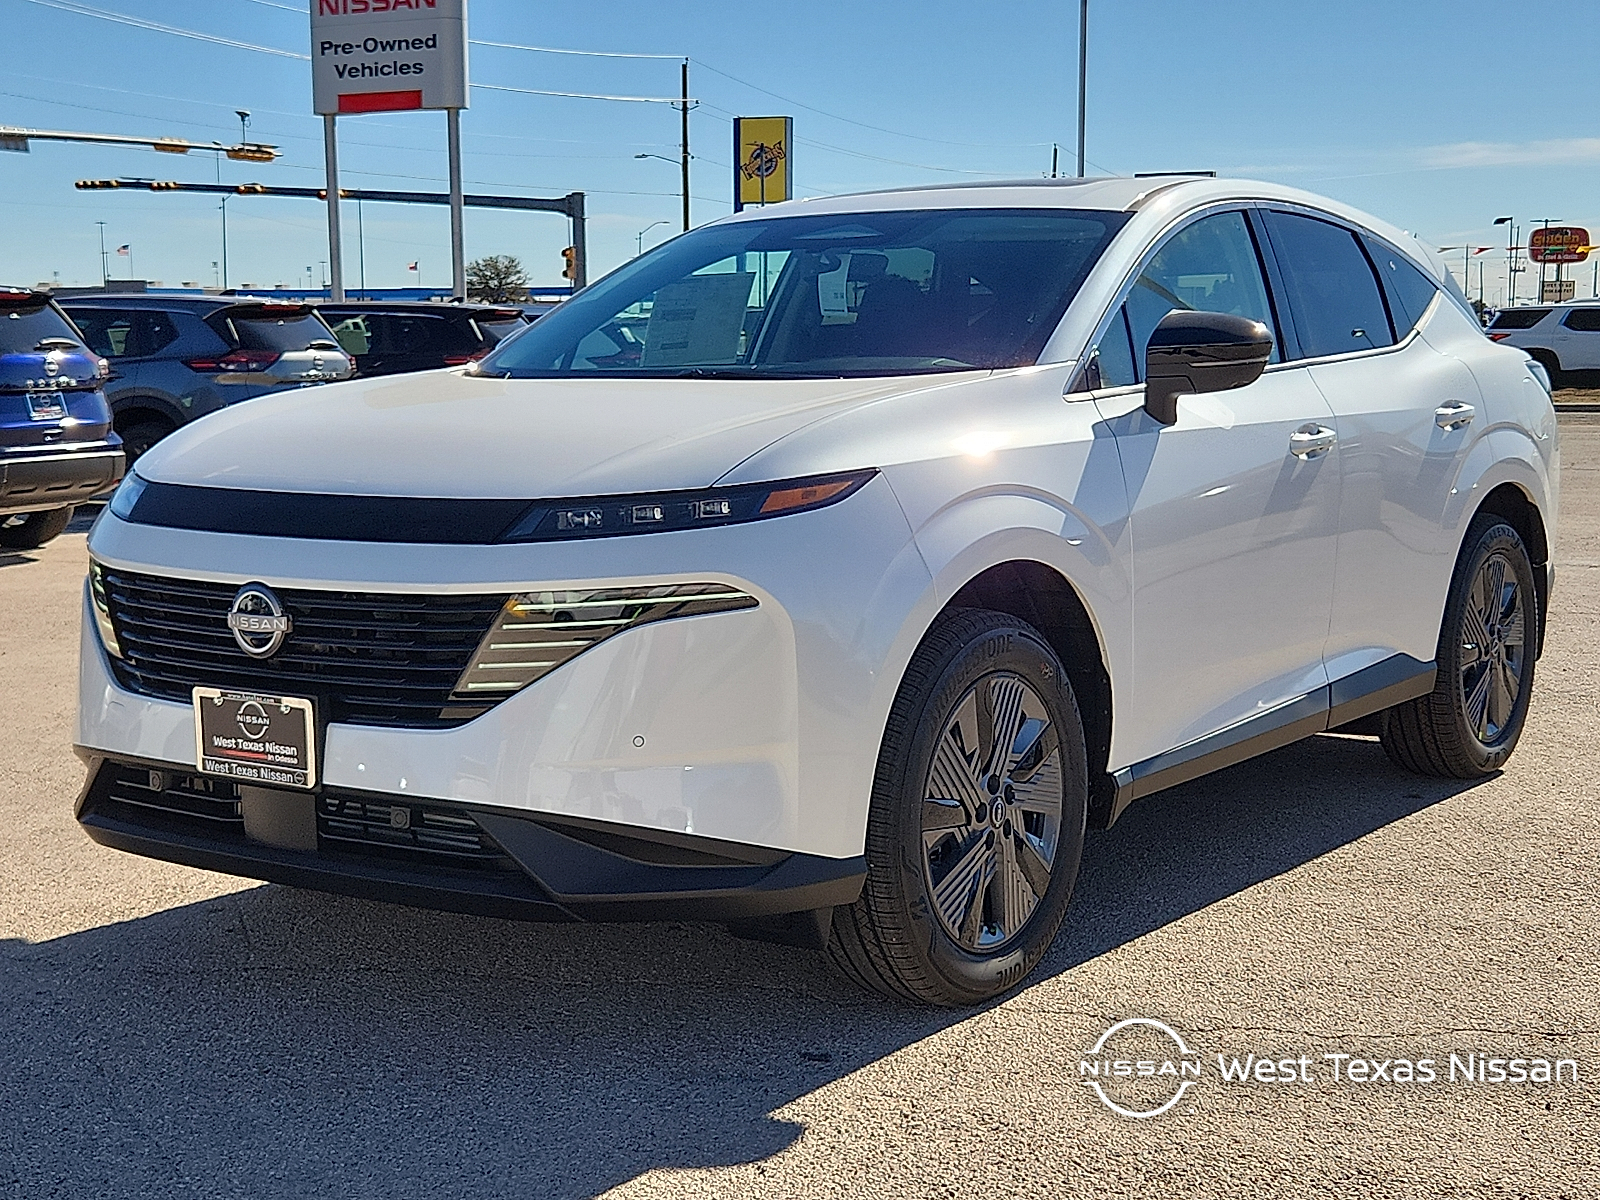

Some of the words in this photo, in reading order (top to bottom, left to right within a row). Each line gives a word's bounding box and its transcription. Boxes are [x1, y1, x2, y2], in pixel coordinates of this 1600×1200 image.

[320, 33, 437, 56] Pre-Owned
[334, 60, 424, 79] Vehicles
[230, 615, 285, 629] NISSAN
[236, 714, 270, 725] NISSAN
[213, 735, 236, 748] West
[237, 738, 264, 752] Texas
[265, 741, 298, 756] Nissan
[205, 759, 229, 772] West
[231, 762, 258, 777] Texas
[260, 766, 294, 782] Nissan
